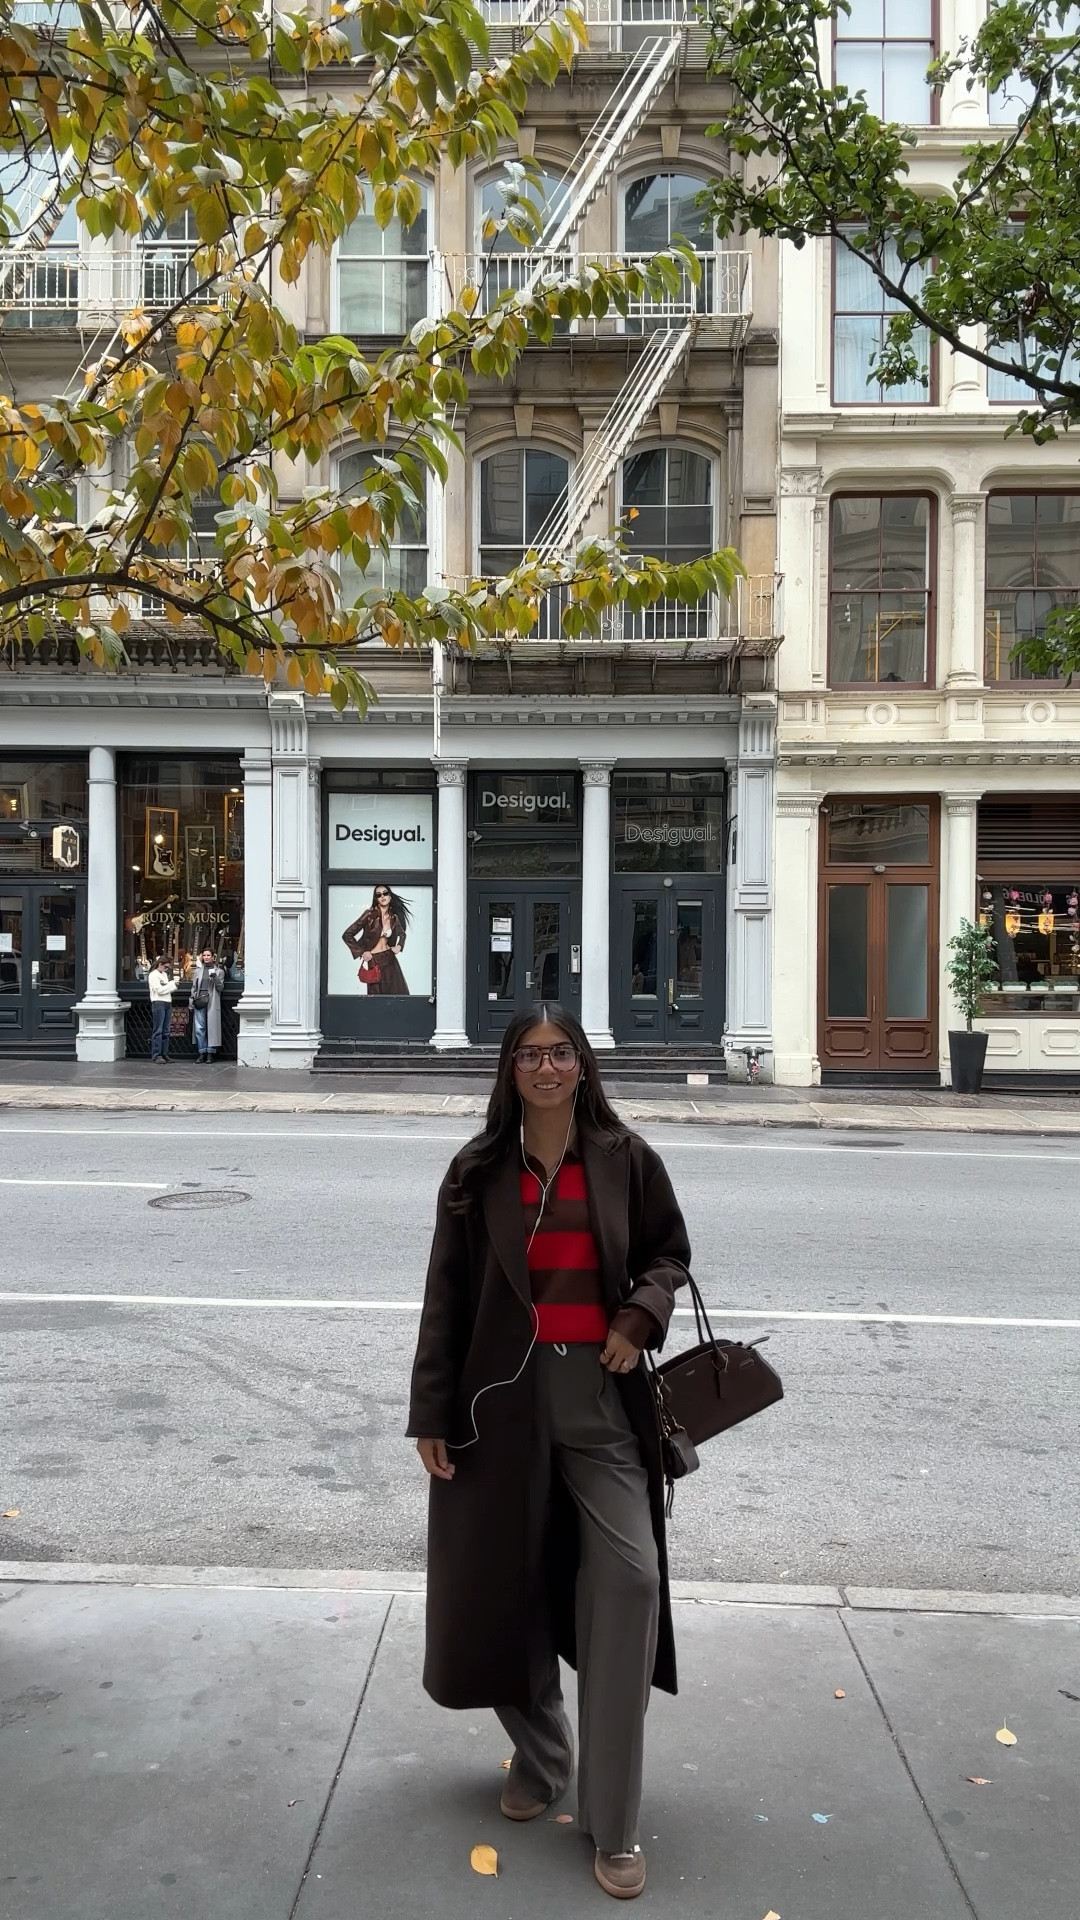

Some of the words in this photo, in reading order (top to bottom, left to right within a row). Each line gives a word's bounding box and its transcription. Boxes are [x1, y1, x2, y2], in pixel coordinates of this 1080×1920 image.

[482, 790, 571, 813] Desigual.
[335, 824, 425, 846] Desigual.
[625, 823, 717, 847] Desigual.
[143, 912, 186, 923] RUDY'S
[188, 912, 230, 923] MUSIC
